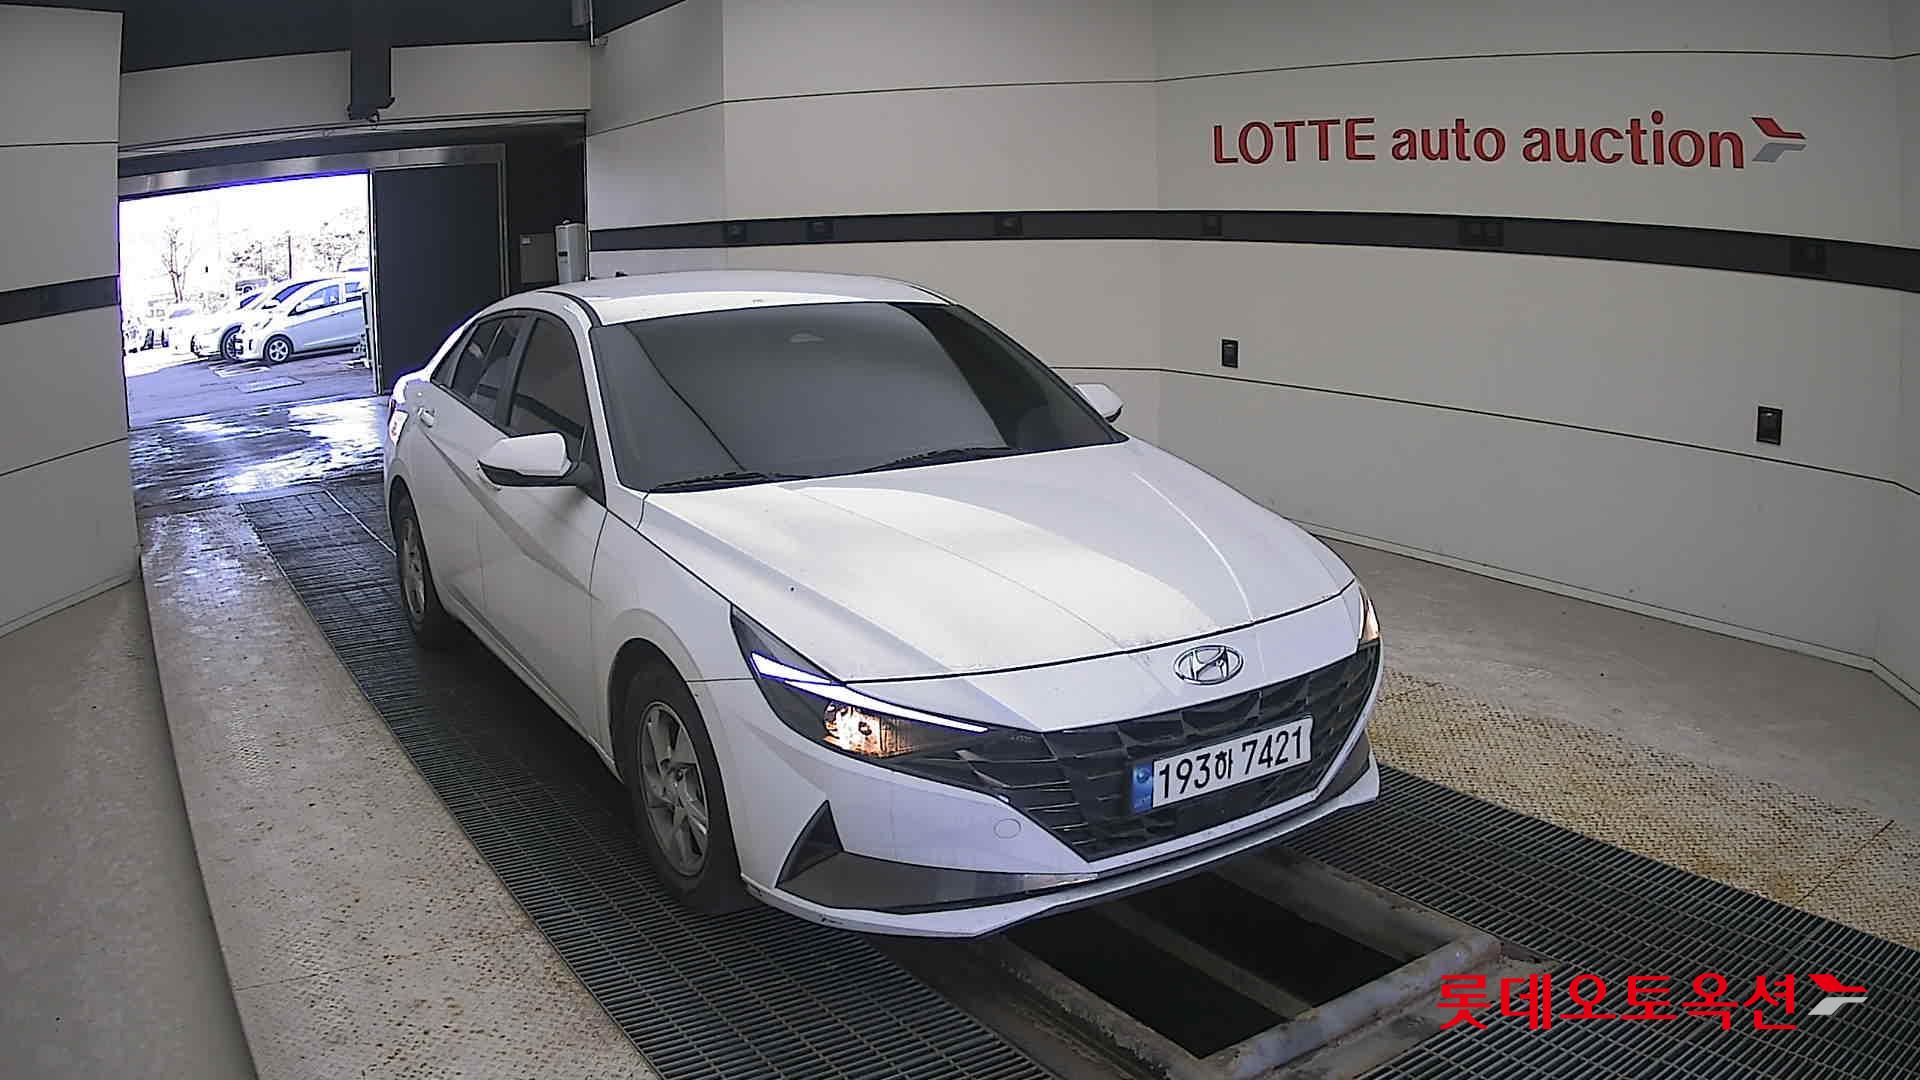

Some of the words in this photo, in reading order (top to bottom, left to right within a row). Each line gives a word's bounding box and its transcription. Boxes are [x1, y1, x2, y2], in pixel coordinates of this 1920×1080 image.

[1213, 117, 1376, 164] LOTTE
[1390, 117, 1507, 163] auto
[1522, 110, 1745, 169] auction
[1159, 748, 1233, 798] 193하
[1242, 725, 1302, 775] 7421
